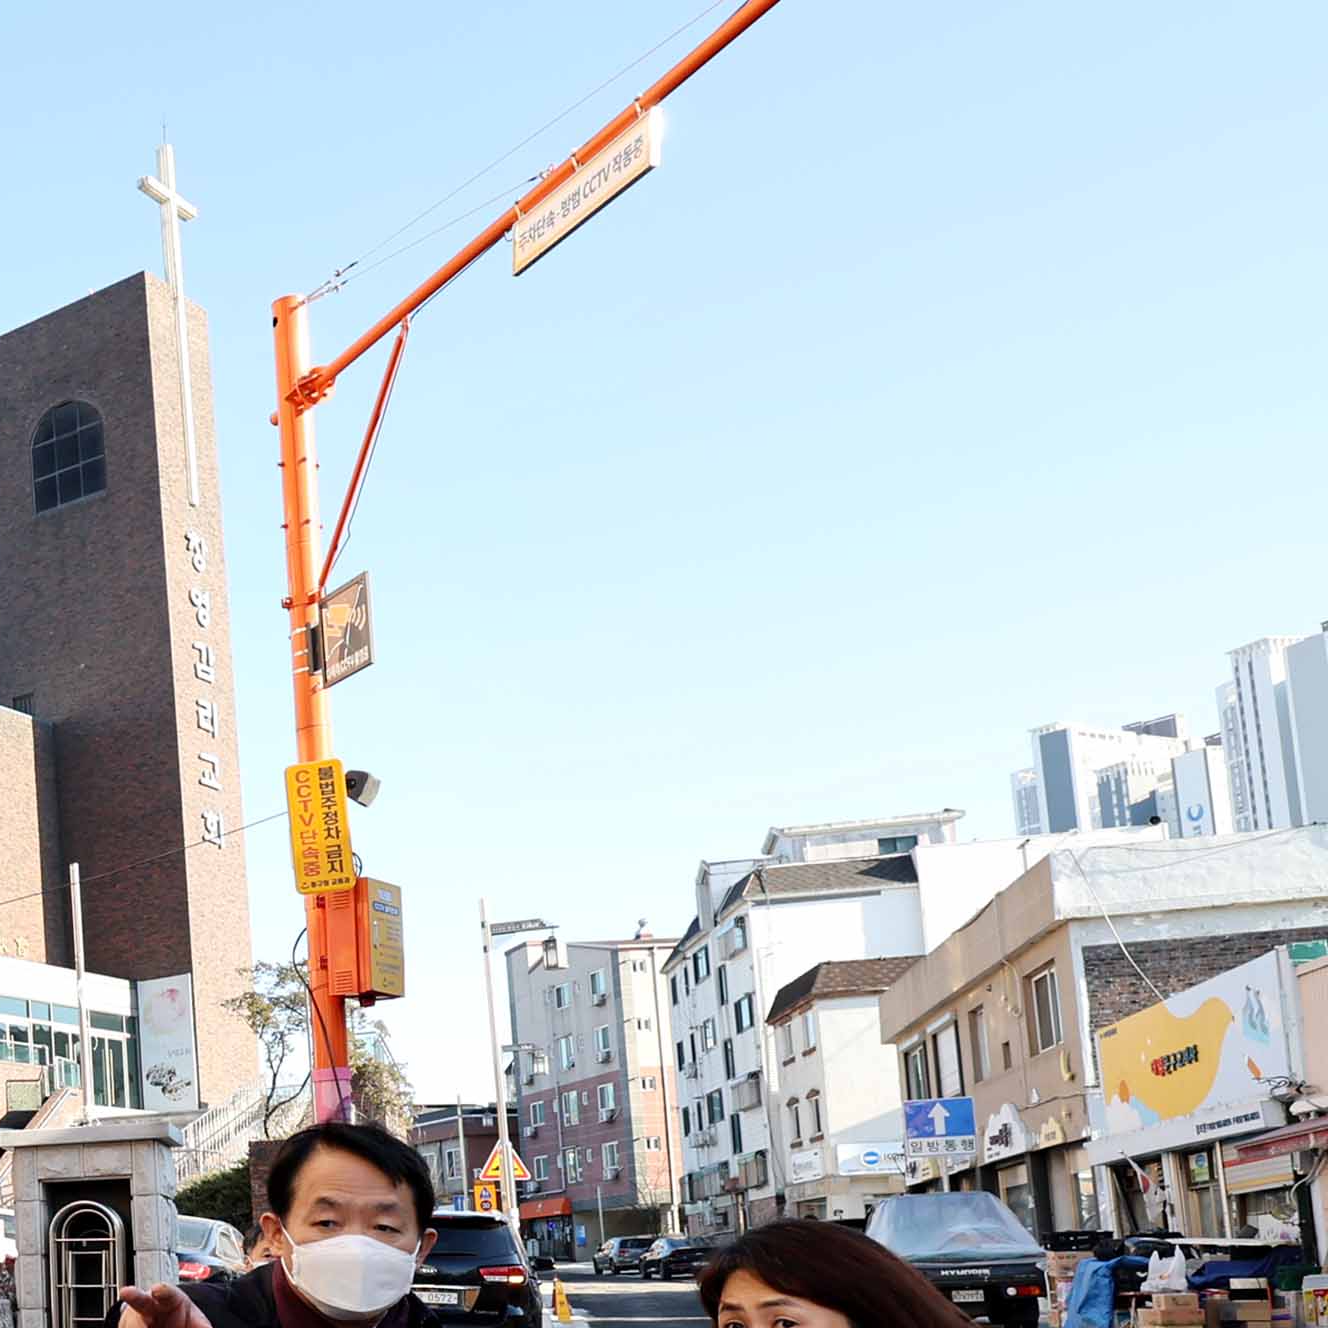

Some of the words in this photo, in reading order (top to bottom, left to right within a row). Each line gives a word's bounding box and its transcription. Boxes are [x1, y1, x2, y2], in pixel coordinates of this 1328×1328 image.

[581, 162, 611, 200] CCTV
[184, 528, 223, 850] 창영감리교회
[317, 765, 342, 841] 불법주정차
[324, 843, 345, 875] 금지
[910, 1138, 975, 1153] 일방통행
